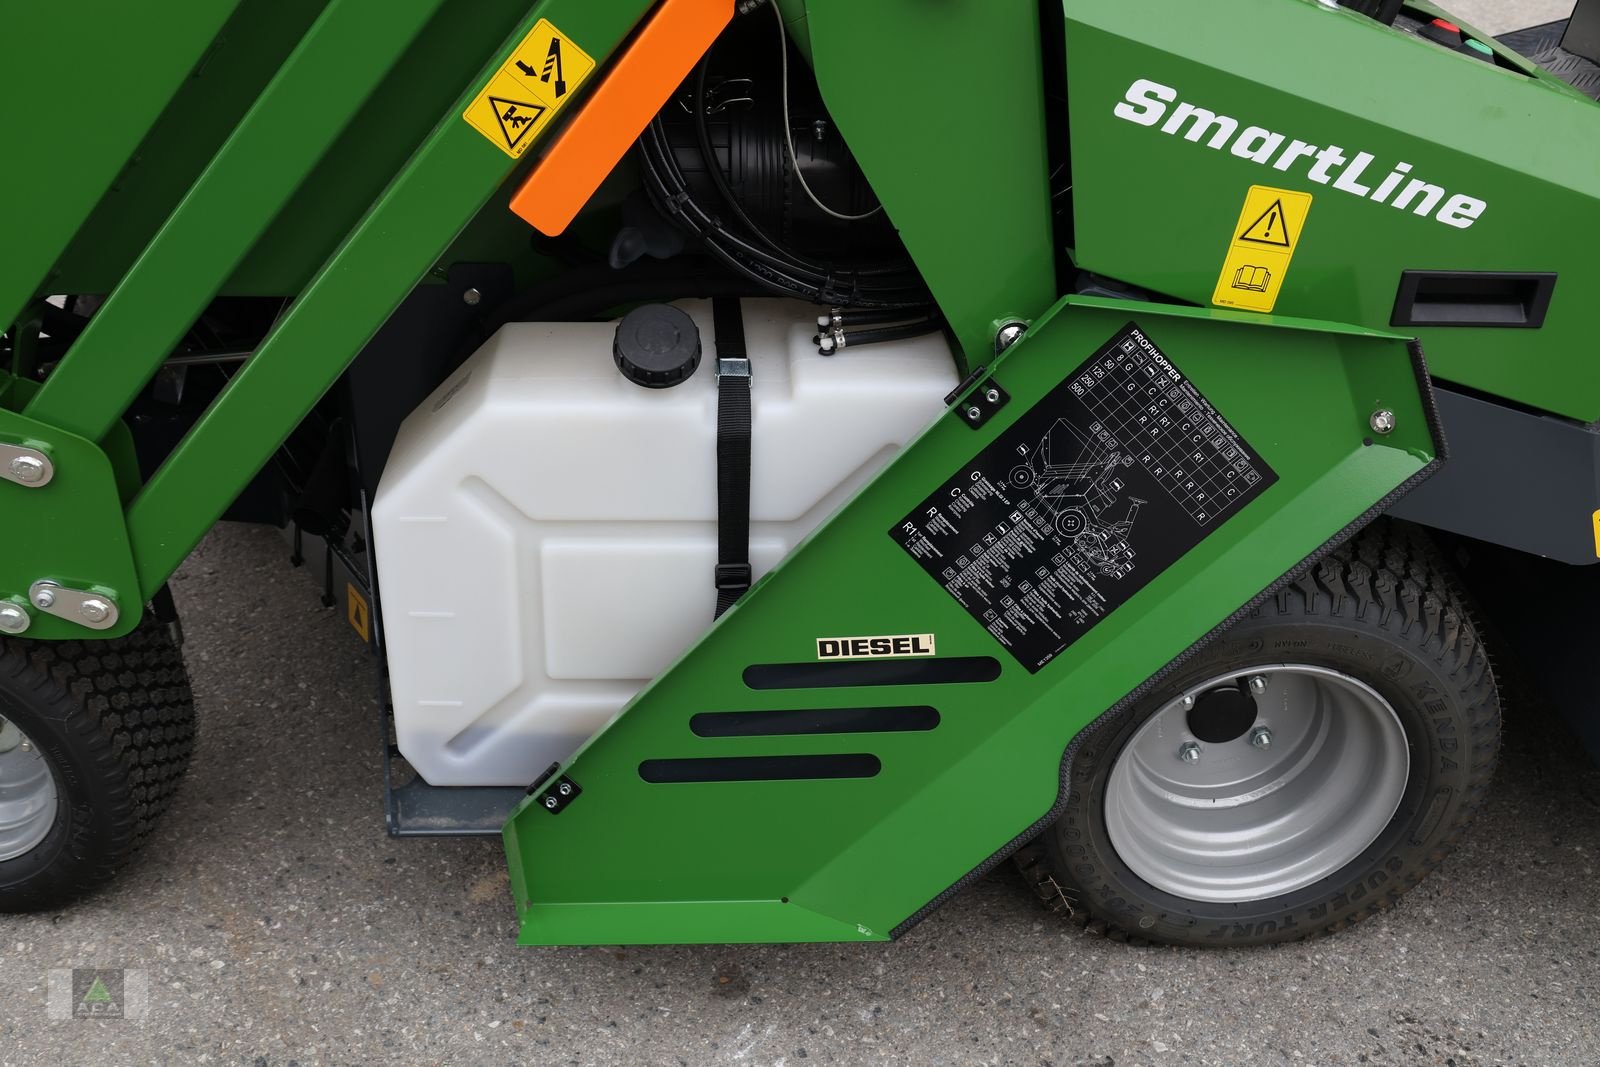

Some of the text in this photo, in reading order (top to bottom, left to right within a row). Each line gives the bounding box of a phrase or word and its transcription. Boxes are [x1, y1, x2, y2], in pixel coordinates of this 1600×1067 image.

[1114, 79, 1487, 229] SmartLine
[1130, 329, 1181, 382] PROFIHOPPER
[1080, 373, 1204, 501] 250 R R R
[1092, 365, 1158, 436] 125 R R
[1104, 359, 1114, 369] 50
[1127, 382, 1135, 390] G
[1148, 404, 1159, 415] R1
[1159, 416, 1170, 427] R1
[1193, 452, 1204, 462] R1
[1148, 387, 1156, 395] C
[1159, 398, 1167, 406] C
[1192, 434, 1201, 442] C
[1226, 470, 1234, 478] C
[970, 470, 981, 480] G
[1071, 382, 1205, 520] 500 R R R
[902, 521, 917, 535] R1
[926, 506, 937, 517] R
[950, 487, 961, 497] C
[819, 637, 930, 657] DIESEL
[1409, 680, 1458, 774] KENDA
[1207, 855, 1404, 940] SUPER TURF
